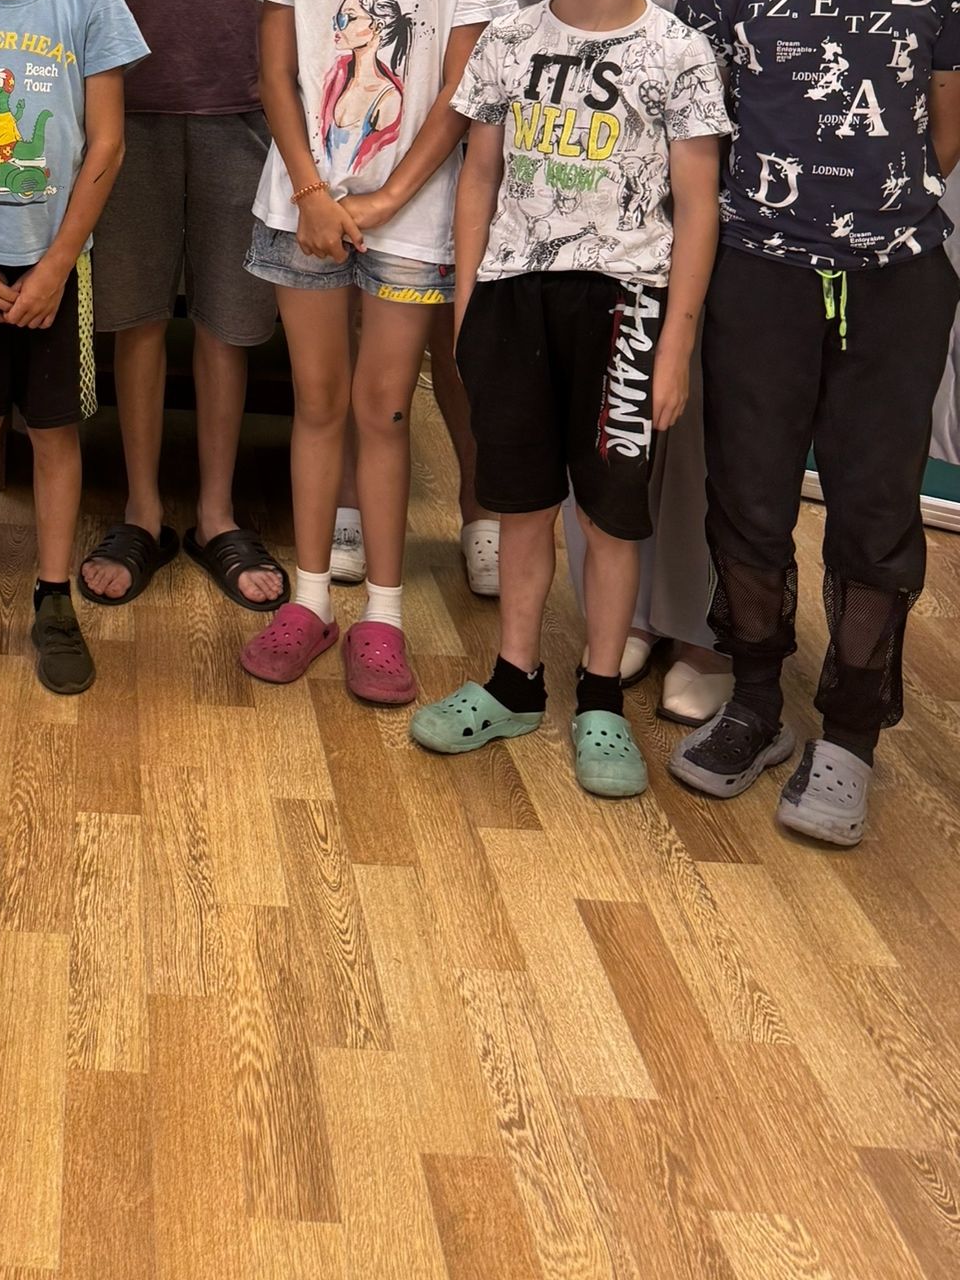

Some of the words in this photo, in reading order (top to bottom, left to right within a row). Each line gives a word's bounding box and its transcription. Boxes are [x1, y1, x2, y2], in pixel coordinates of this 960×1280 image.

[25, 62, 59, 78] Beach
[791, 71, 827, 81] LODND
[23, 78, 53, 93] Tour
[524, 53, 623, 111] IT'S
[511, 100, 621, 161] WILD
